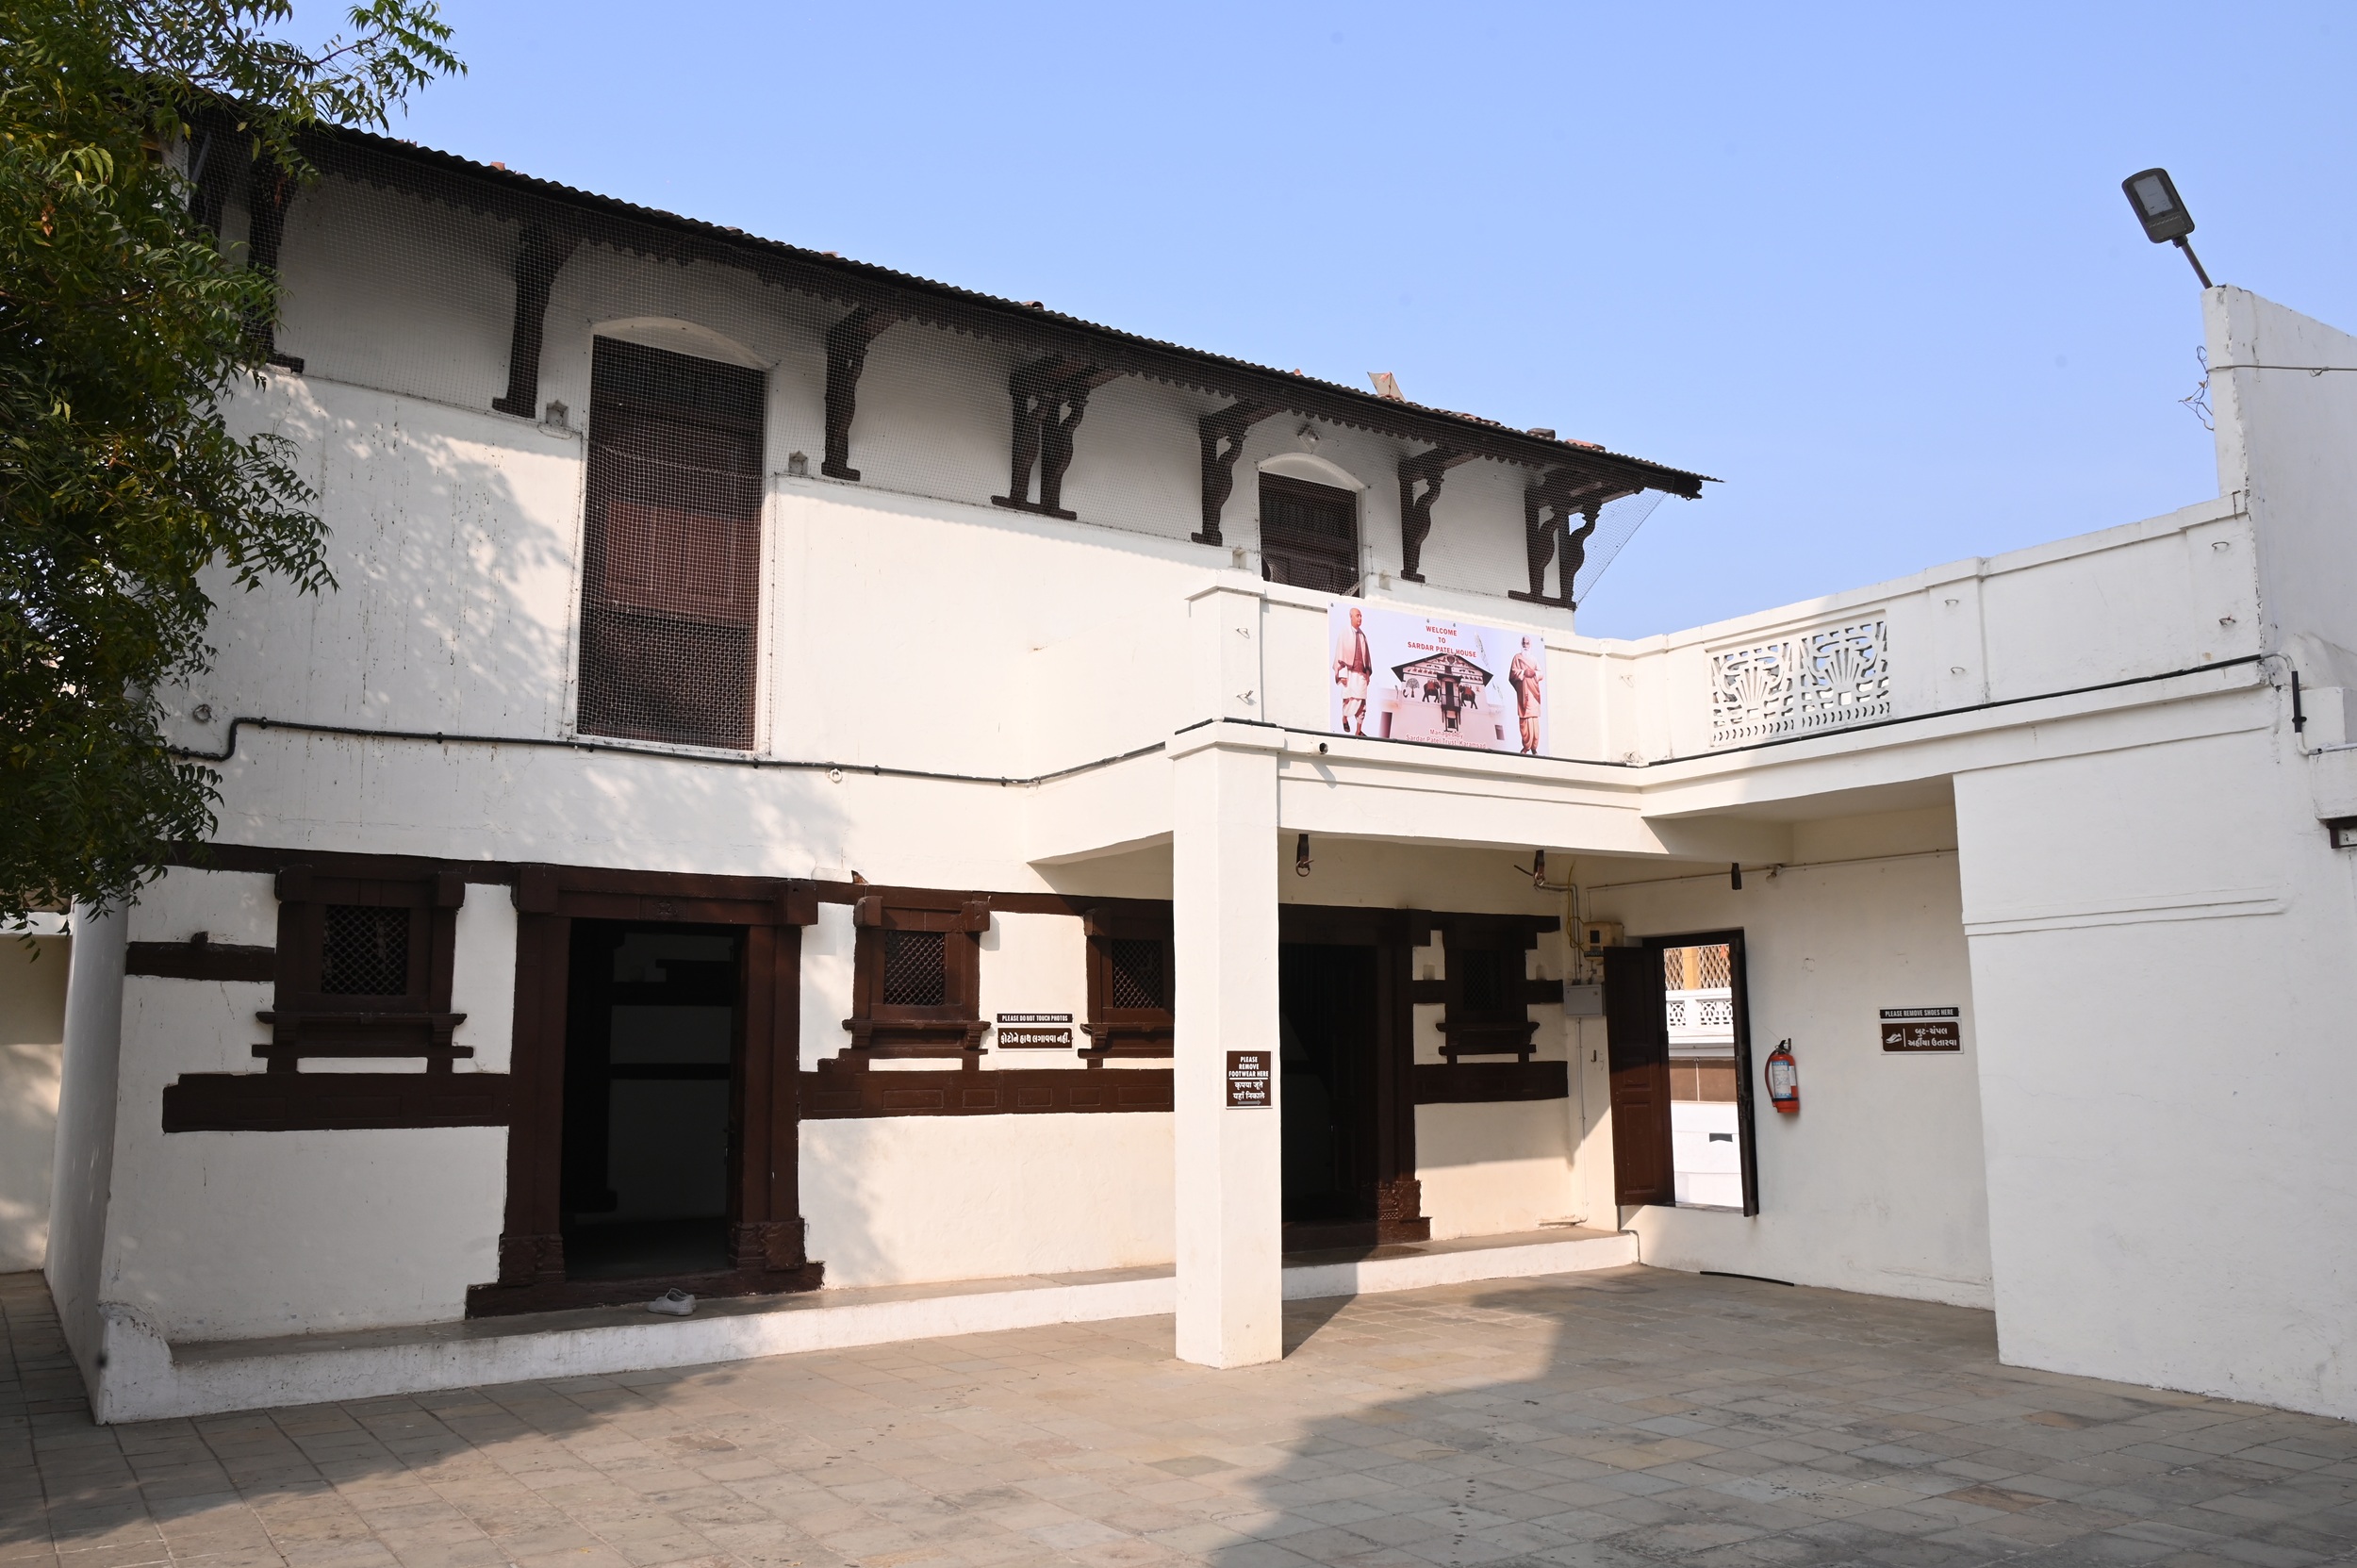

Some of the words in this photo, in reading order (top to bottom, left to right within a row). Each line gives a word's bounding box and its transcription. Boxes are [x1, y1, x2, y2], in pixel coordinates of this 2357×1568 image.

[1426, 625, 1458, 636] WELCOME
[1408, 641, 1434, 652] SARDAR
[1456, 649, 1476, 657] HOUSE
[1429, 729, 1457, 737] Managed
[1234, 1081, 1252, 1090] कृपया
